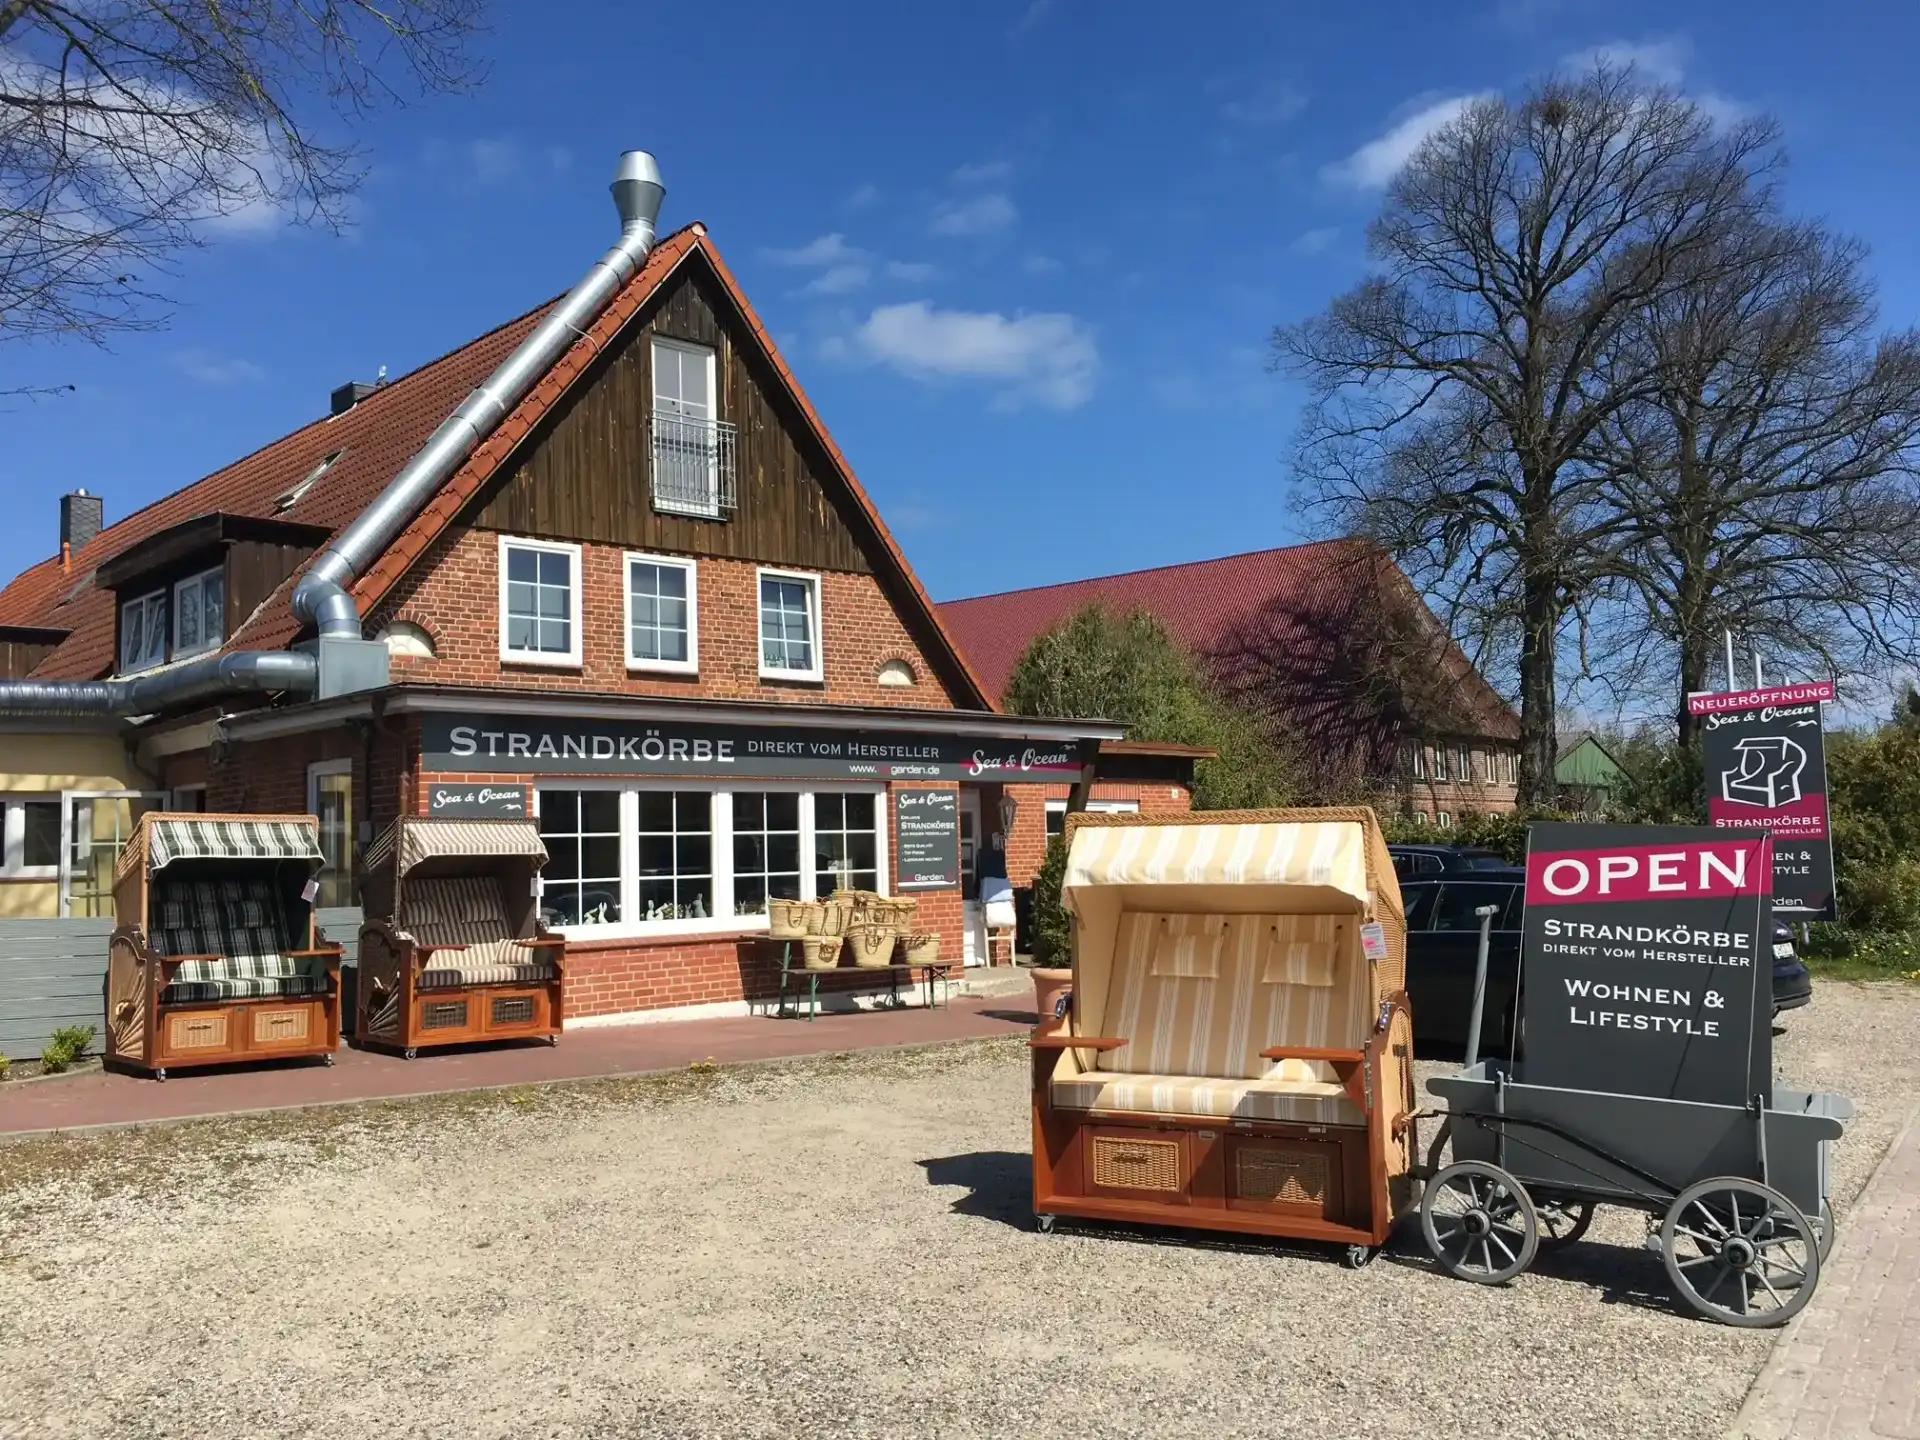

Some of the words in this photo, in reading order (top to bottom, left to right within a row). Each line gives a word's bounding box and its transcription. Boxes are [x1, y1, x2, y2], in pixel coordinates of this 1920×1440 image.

[1692, 685, 1830, 711] NEUERÖFFNUNG
[1706, 711, 1740, 731] Sea
[1743, 711, 1756, 721] &
[1760, 704, 1816, 723] Ocean
[449, 726, 735, 763] STRANDKÖRBE
[748, 740, 805, 755] DIREKT
[810, 743, 842, 756] VOM
[848, 742, 940, 759] HERSTELLER
[969, 749, 1002, 776] Sea
[1005, 754, 1017, 768] &
[1020, 748, 1069, 772] Ocean
[432, 789, 463, 809] Sea
[465, 792, 475, 802] &
[478, 787, 521, 804] Ocean
[899, 793, 917, 809] Sea
[926, 792, 954, 806] Ocean
[901, 821, 955, 830] STRANDKÖRBE
[1715, 814, 1821, 828] STRANDKÖRBE
[1800, 850, 1811, 861] &
[914, 873, 945, 882] Garden
[1543, 849, 1747, 896] OPEN
[1771, 866, 1810, 875] TYLE
[1544, 918, 1750, 949] STRANDKÖRBE
[1543, 943, 1598, 956] DIREKT
[1603, 947, 1636, 959] VOM
[1643, 948, 1750, 967] HERSTELLER
[1564, 978, 1691, 1007] WOHNEN
[1703, 990, 1725, 1009] &
[1570, 1006, 1720, 1037] LIFESTYLE
